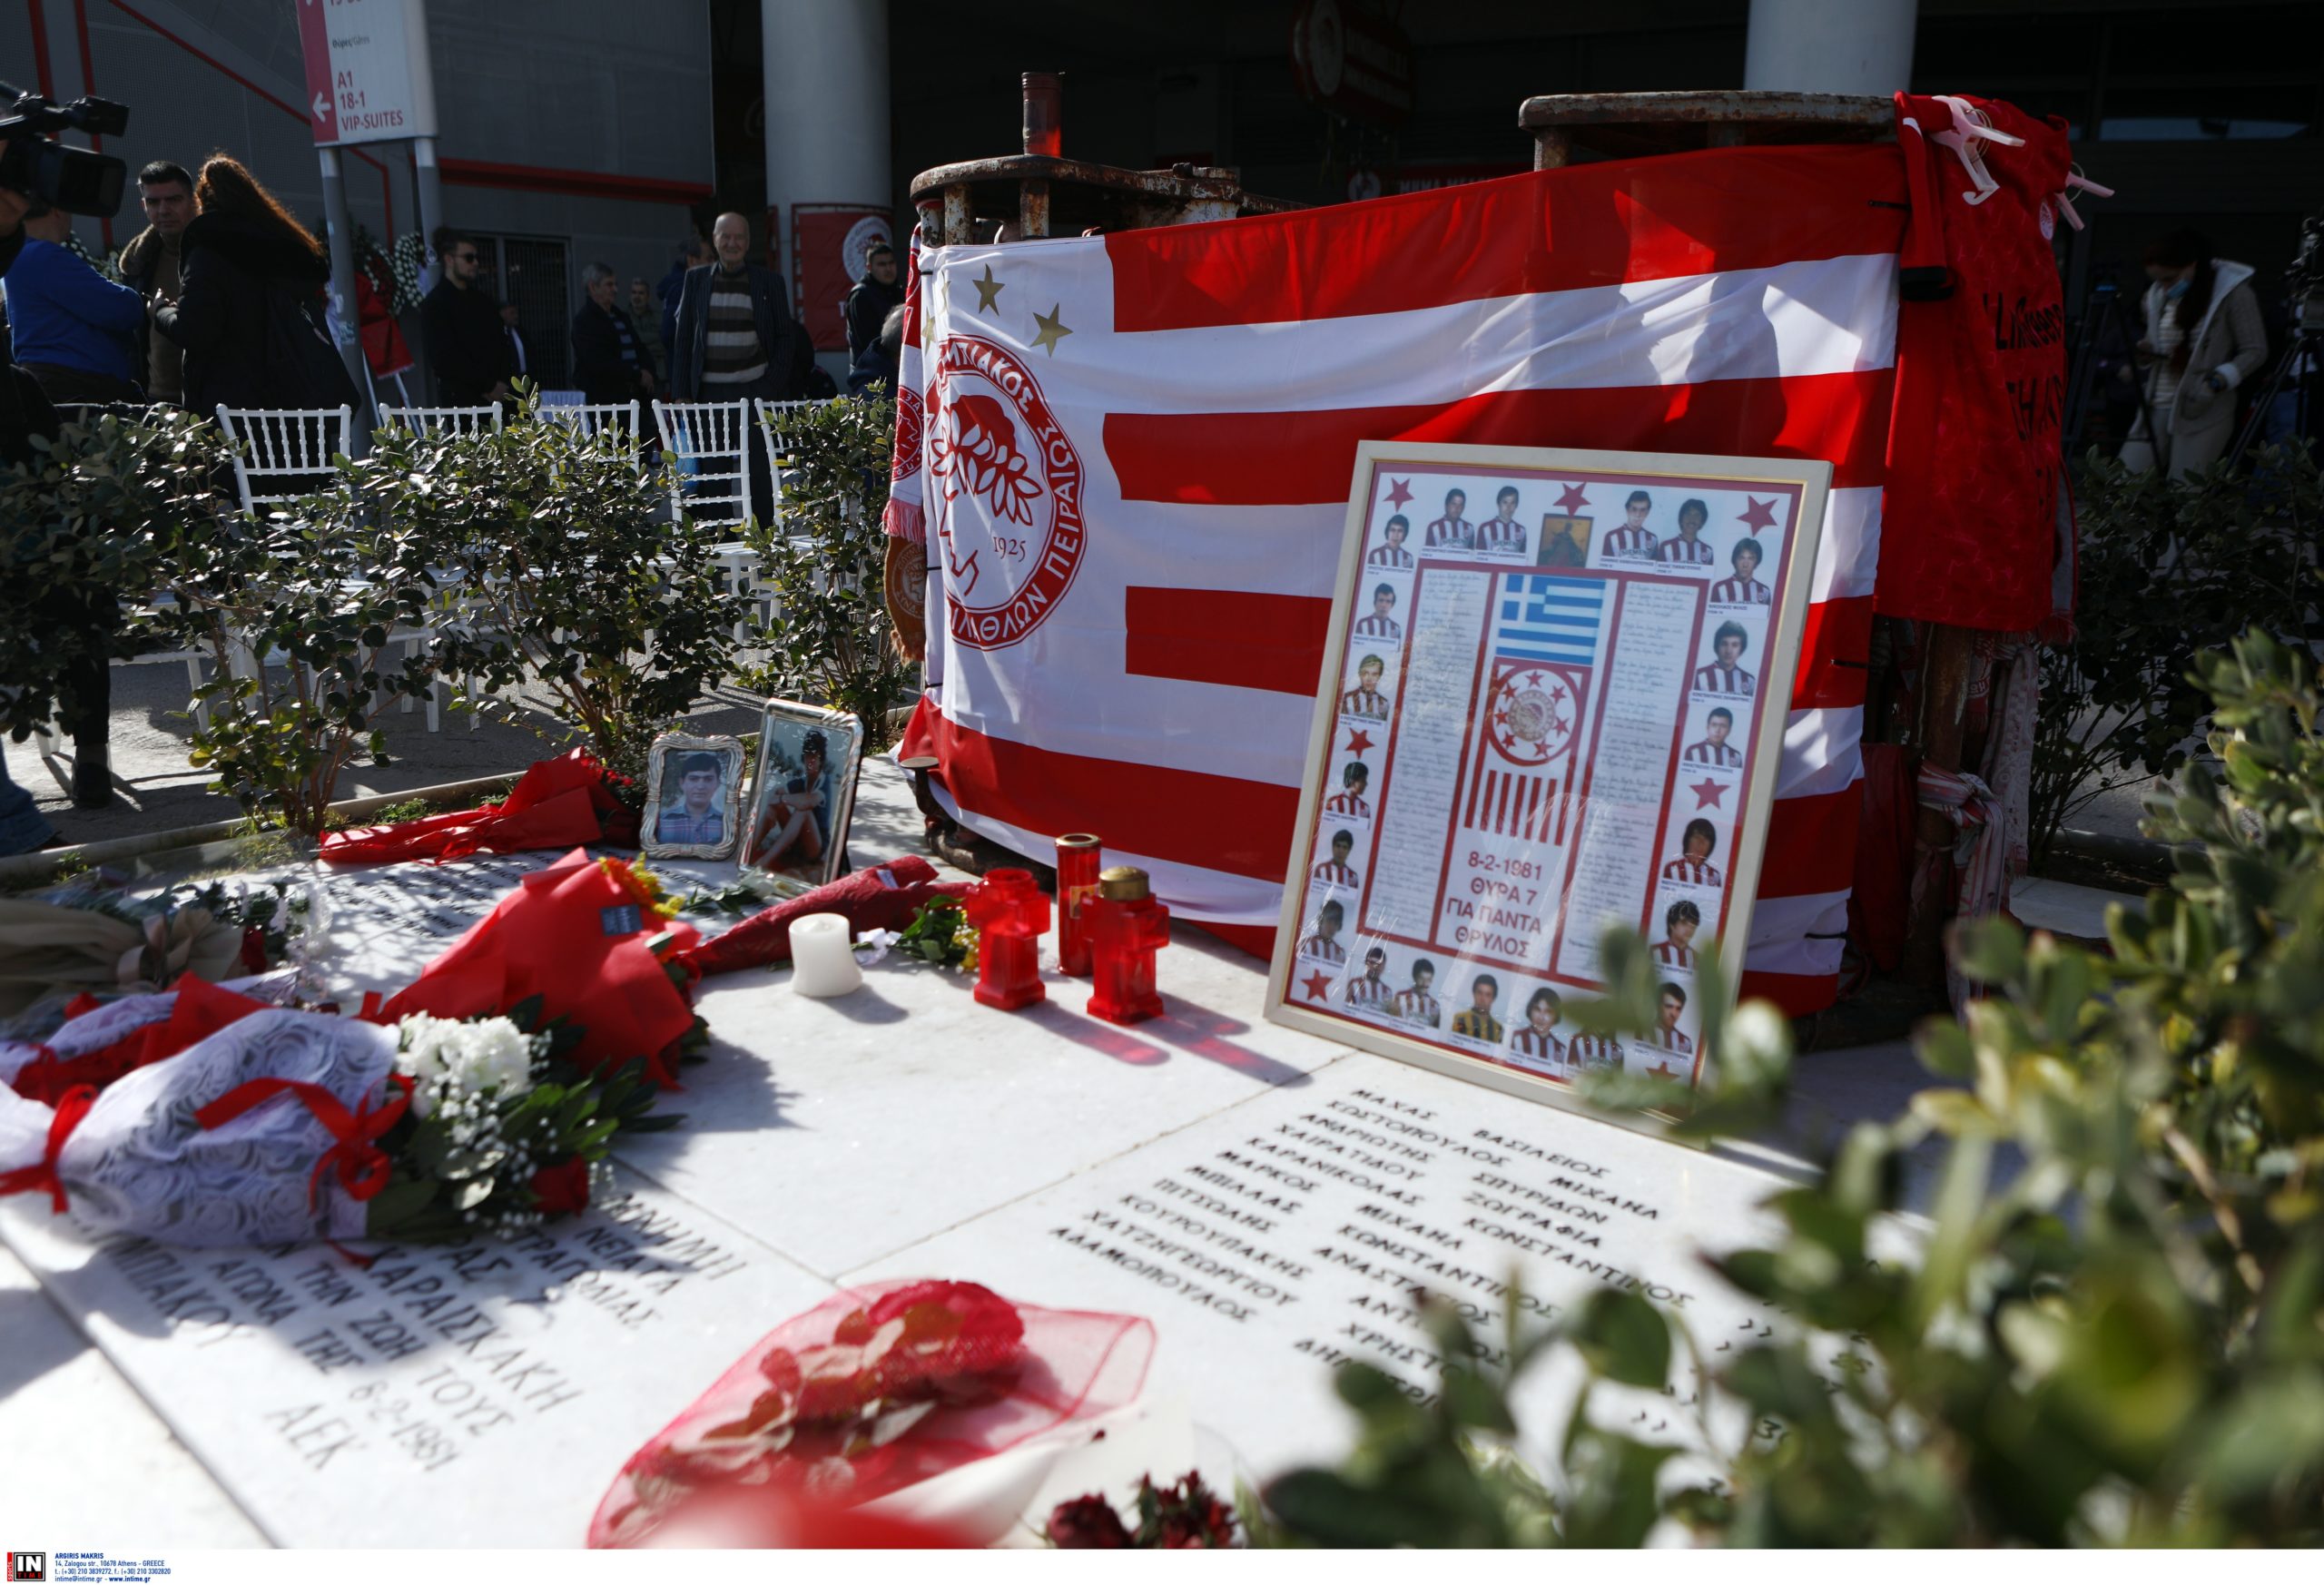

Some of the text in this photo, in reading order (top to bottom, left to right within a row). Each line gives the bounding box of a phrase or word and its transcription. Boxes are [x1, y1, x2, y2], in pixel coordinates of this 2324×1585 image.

[337, 71, 353, 88] A1
[340, 91, 366, 109] 18-1
[341, 110, 403, 131] VIP-SUITES
[1037, 418, 1080, 581] ΠΕΙΡΑΙΩΣ
[992, 536, 1027, 563] 1925
[1467, 851, 1542, 881] 8-2-1981
[1471, 876, 1538, 906] ΘΥΡΑ 7
[1446, 897, 1542, 935] ΓΙΑ ΠΑΝΤΑ
[1454, 925, 1531, 958] ΘΡΥΛΟΣ
[1325, 1099, 1512, 1167] ΚΩΣΤΟΠΟΥΛΟΣ
[1349, 1088, 1611, 1179] ΜΑΧΑΣ ΒΑΣΙΛΕΙΟΣ
[1246, 1136, 1426, 1207] ΚΑΡΑΝΙΚΟΛΑΣ
[1462, 1190, 1602, 1249] ΖΩΓΡΑΦΙΑ
[1472, 1172, 1609, 1226] ΣΠΥΡΙΔΩΝ
[1354, 1203, 1464, 1250] ΜΙΧΑΗΛ
[294, 1263, 516, 1437] ΤΗΝ ΖΩΗ ΤΟΥΣ
